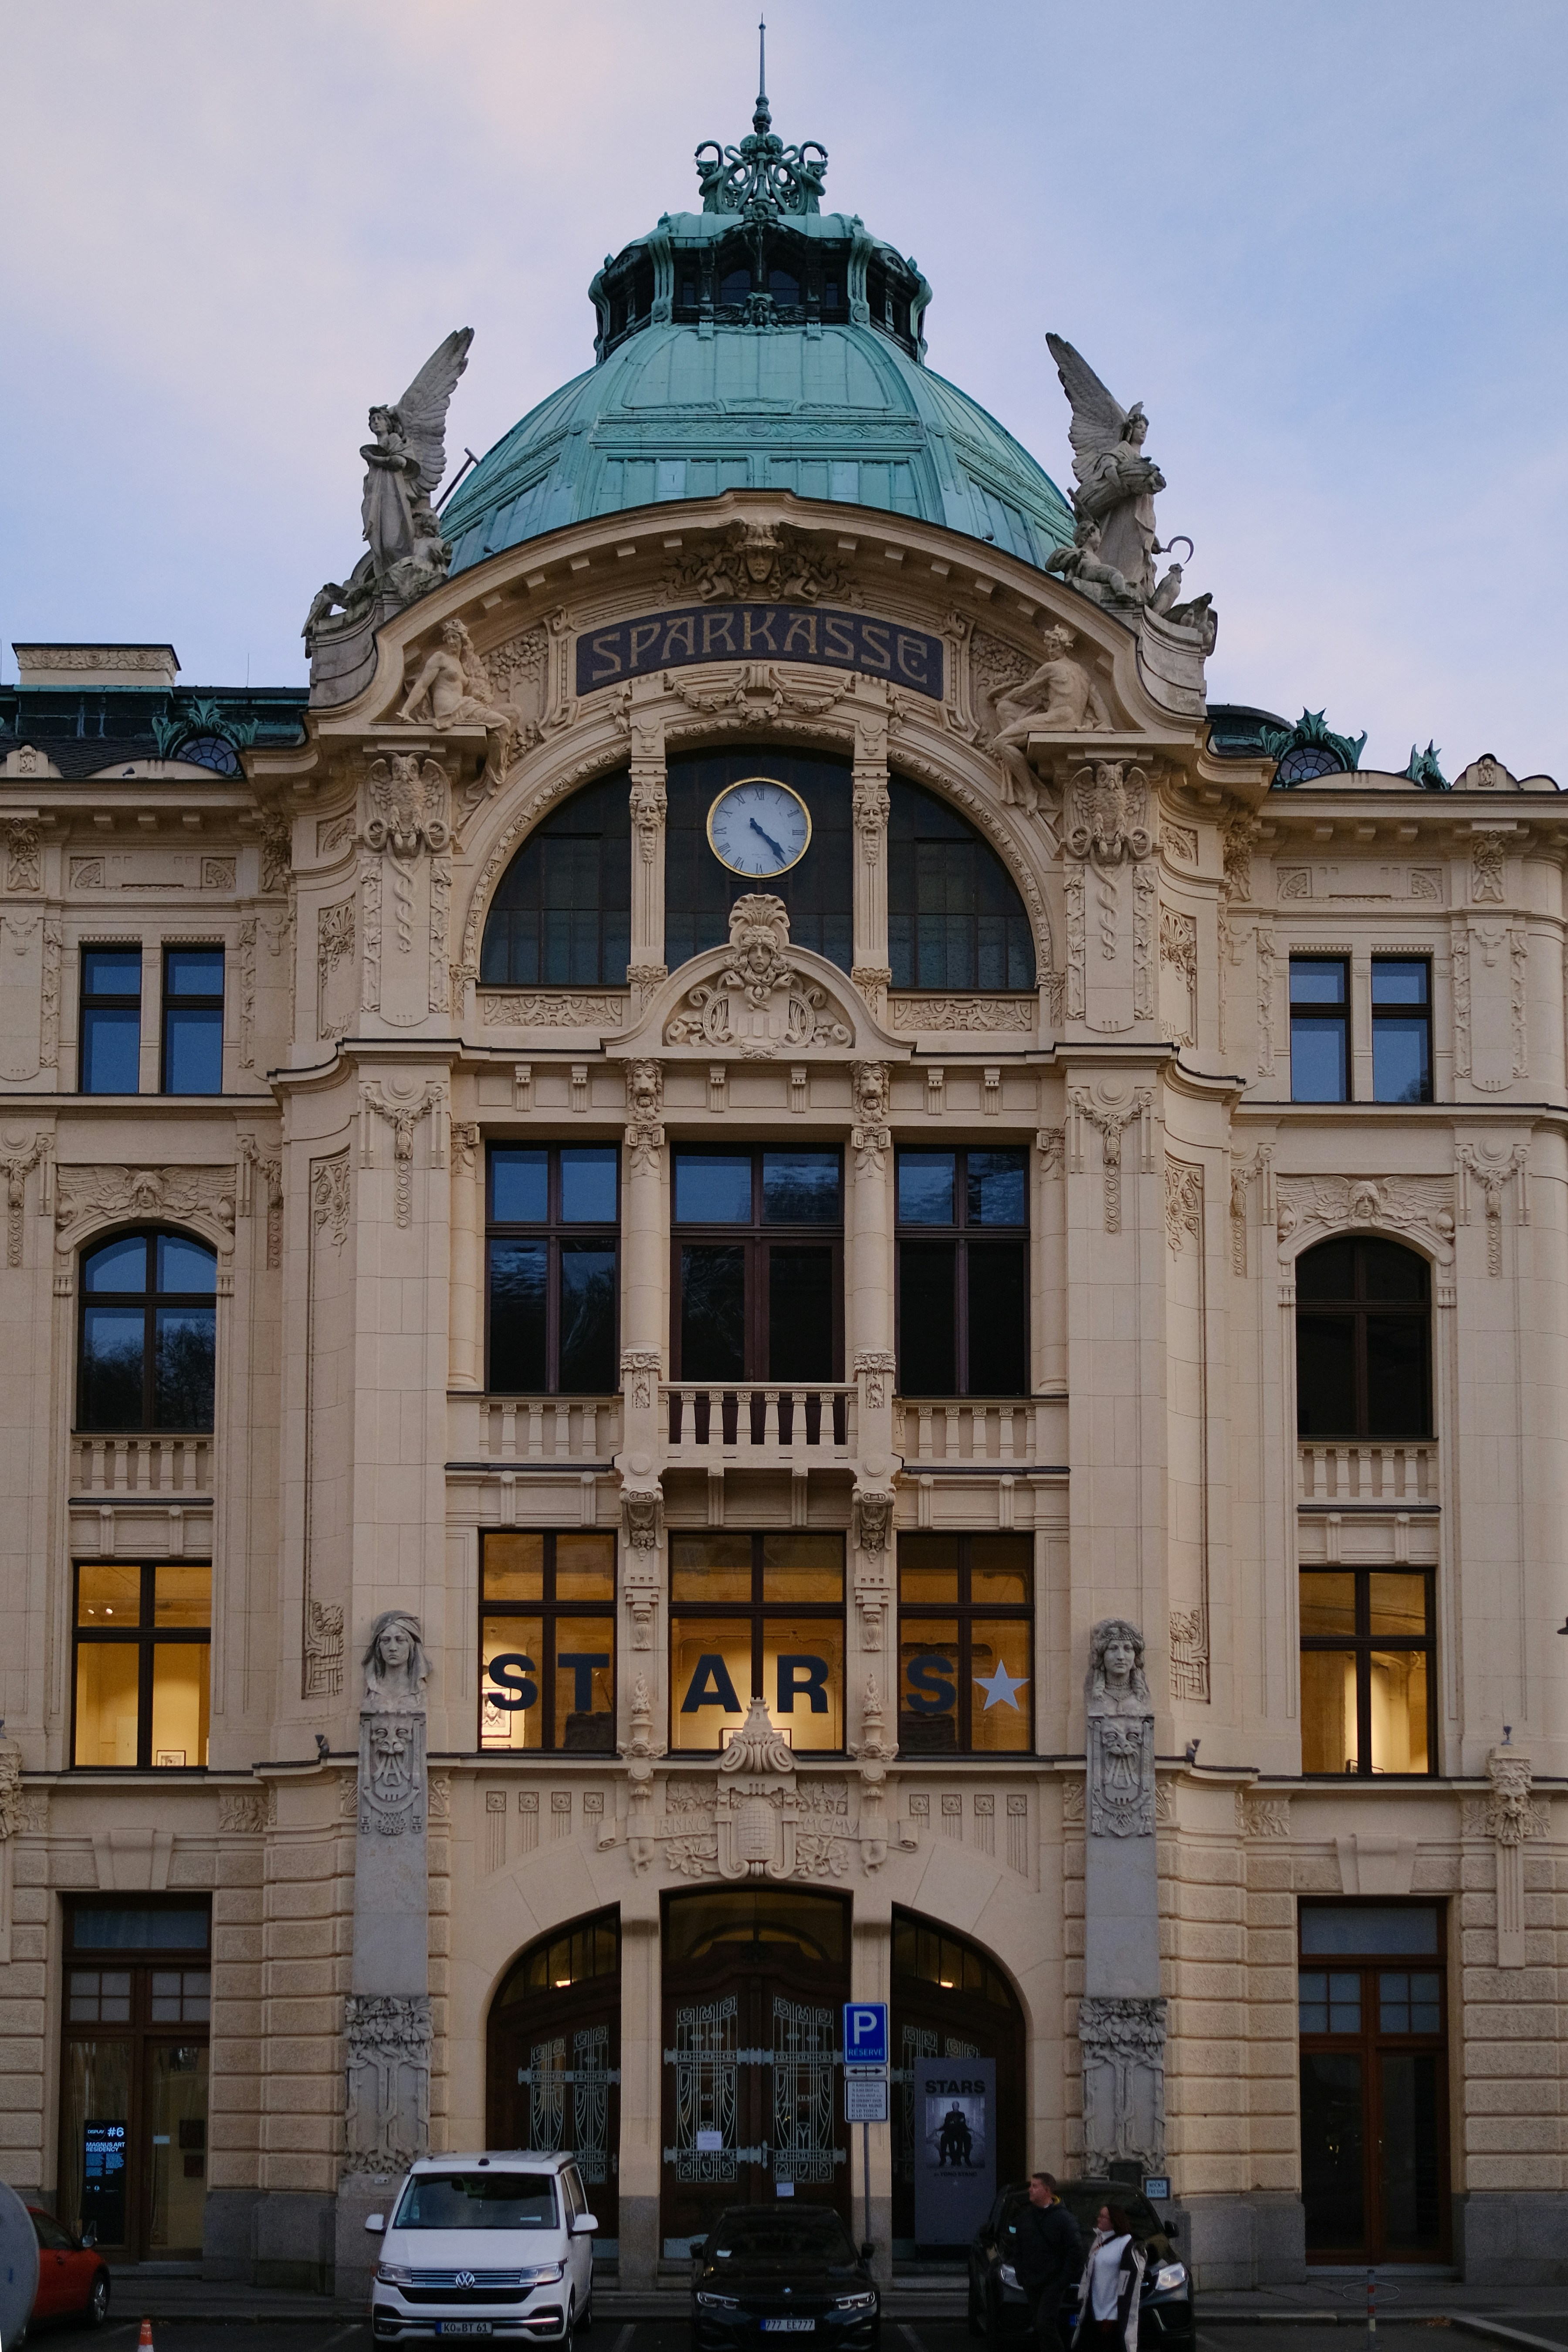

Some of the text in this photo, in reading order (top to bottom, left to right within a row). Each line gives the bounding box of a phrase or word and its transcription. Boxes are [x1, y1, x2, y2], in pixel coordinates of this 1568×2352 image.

[592, 611, 928, 684] SPARKASSE
[734, 793, 745, 806] XI
[755, 789, 765, 800] XII
[719, 807, 733, 818] X
[787, 809, 800, 818] II
[756, 863, 763, 874] VI
[487, 1653, 957, 1714] STARS
[659, 1815, 710, 1835] ANNO
[853, 2011, 877, 2044] P
[925, 2080, 986, 2094] STARS
[107, 2127, 124, 2137] #6
[444, 2323, 488, 2332] KO BT 61
